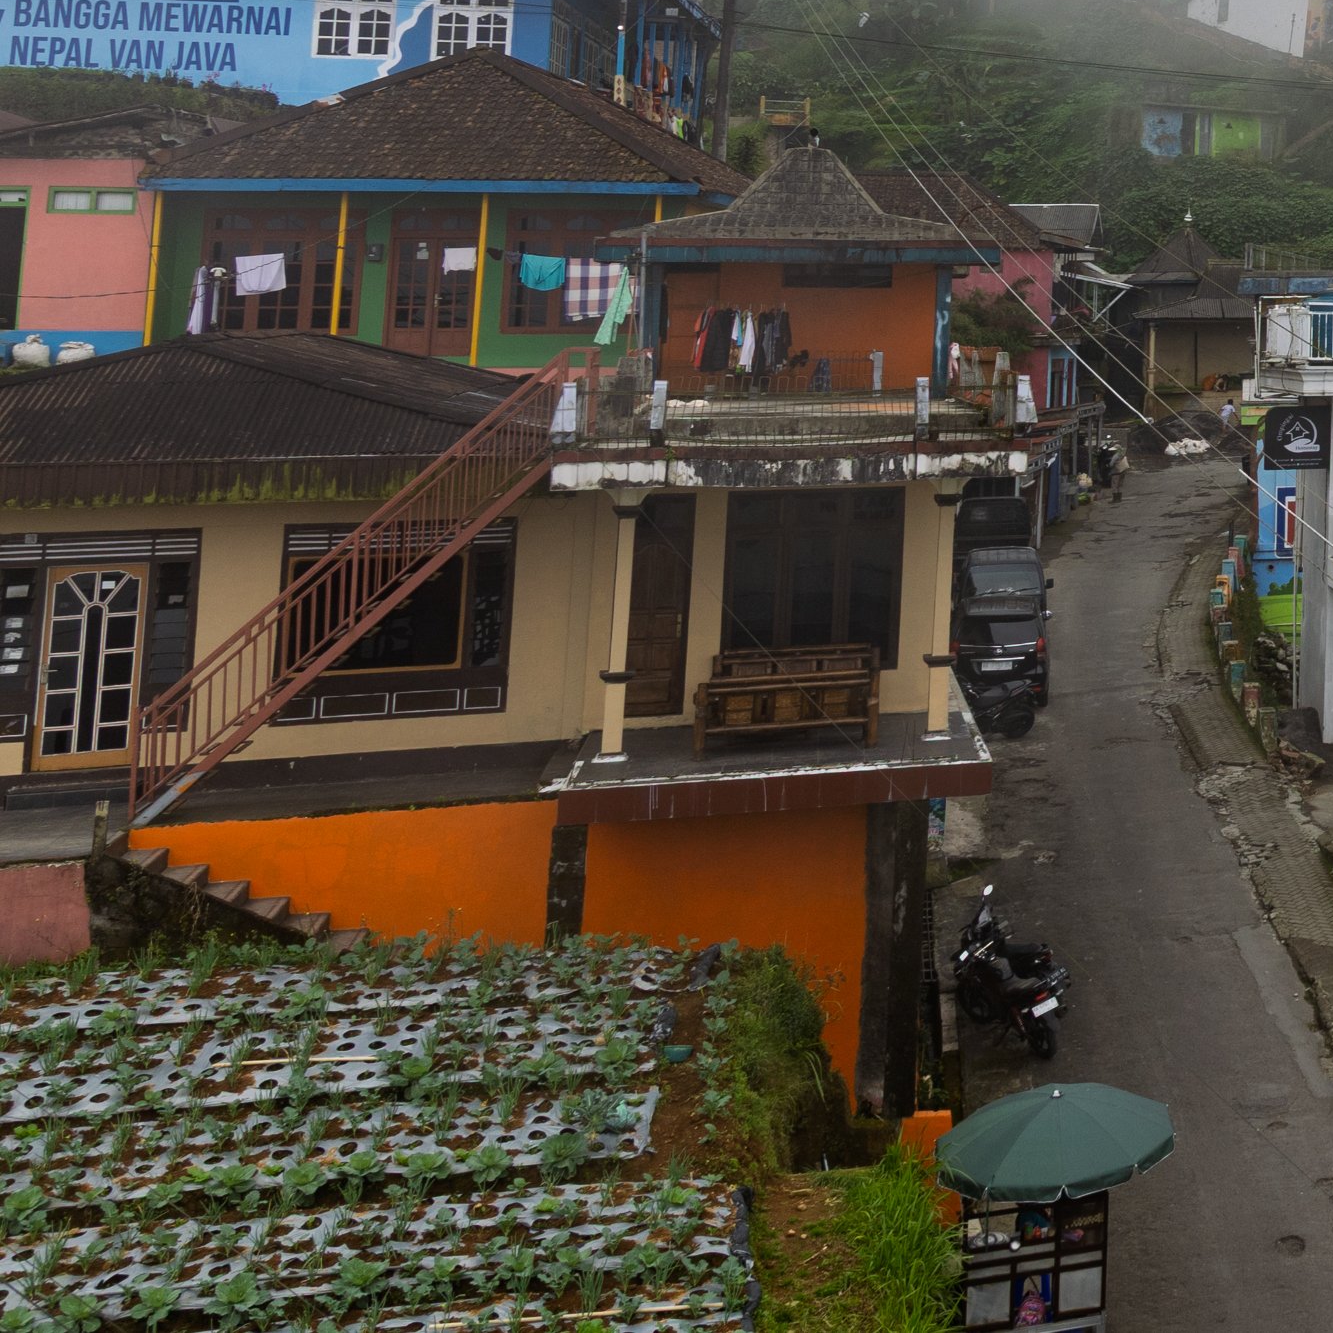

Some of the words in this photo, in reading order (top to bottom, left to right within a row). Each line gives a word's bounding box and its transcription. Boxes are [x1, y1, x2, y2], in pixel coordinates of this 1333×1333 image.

[138, 2, 292, 36] MEWARNAI
[9, 35, 99, 67] NEPAL
[110, 38, 164, 70] VAN
[172, 40, 237, 72] JAVA
